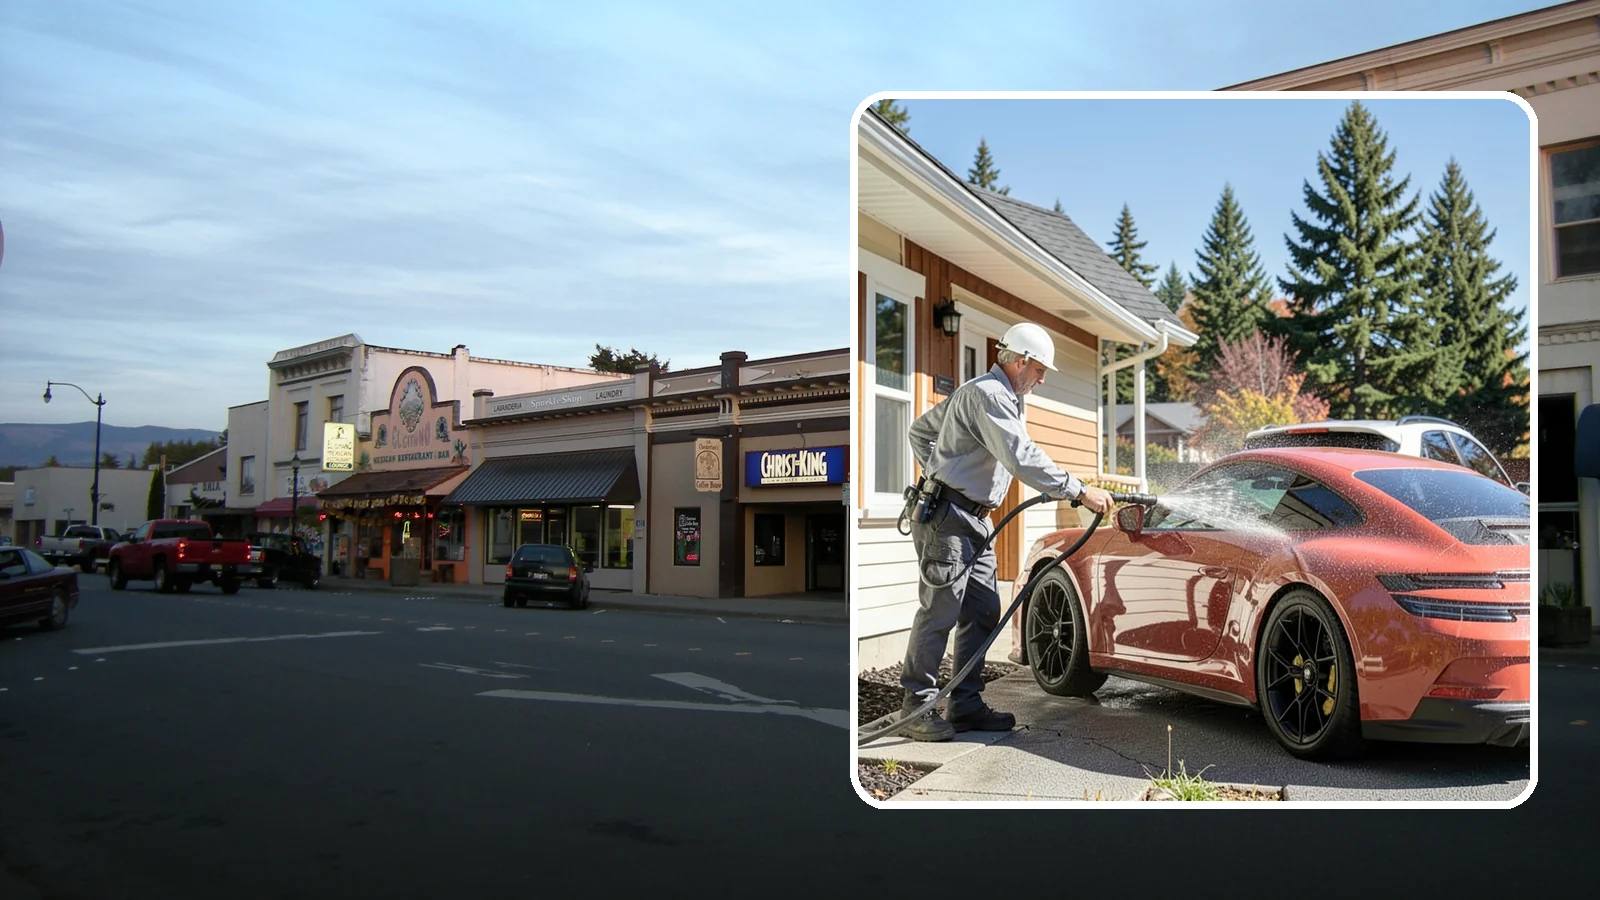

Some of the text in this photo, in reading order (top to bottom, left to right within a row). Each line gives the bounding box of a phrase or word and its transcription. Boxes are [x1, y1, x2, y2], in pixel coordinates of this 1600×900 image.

[595, 389, 623, 400] LAUNDRY
[493, 402, 523, 413] LAVANDERIA
[373, 455, 396, 464] MEXICAN
[398, 451, 433, 463] RESTAURANT
[438, 450, 450, 459] BAR
[761, 450, 827, 477] CHRIST KING
